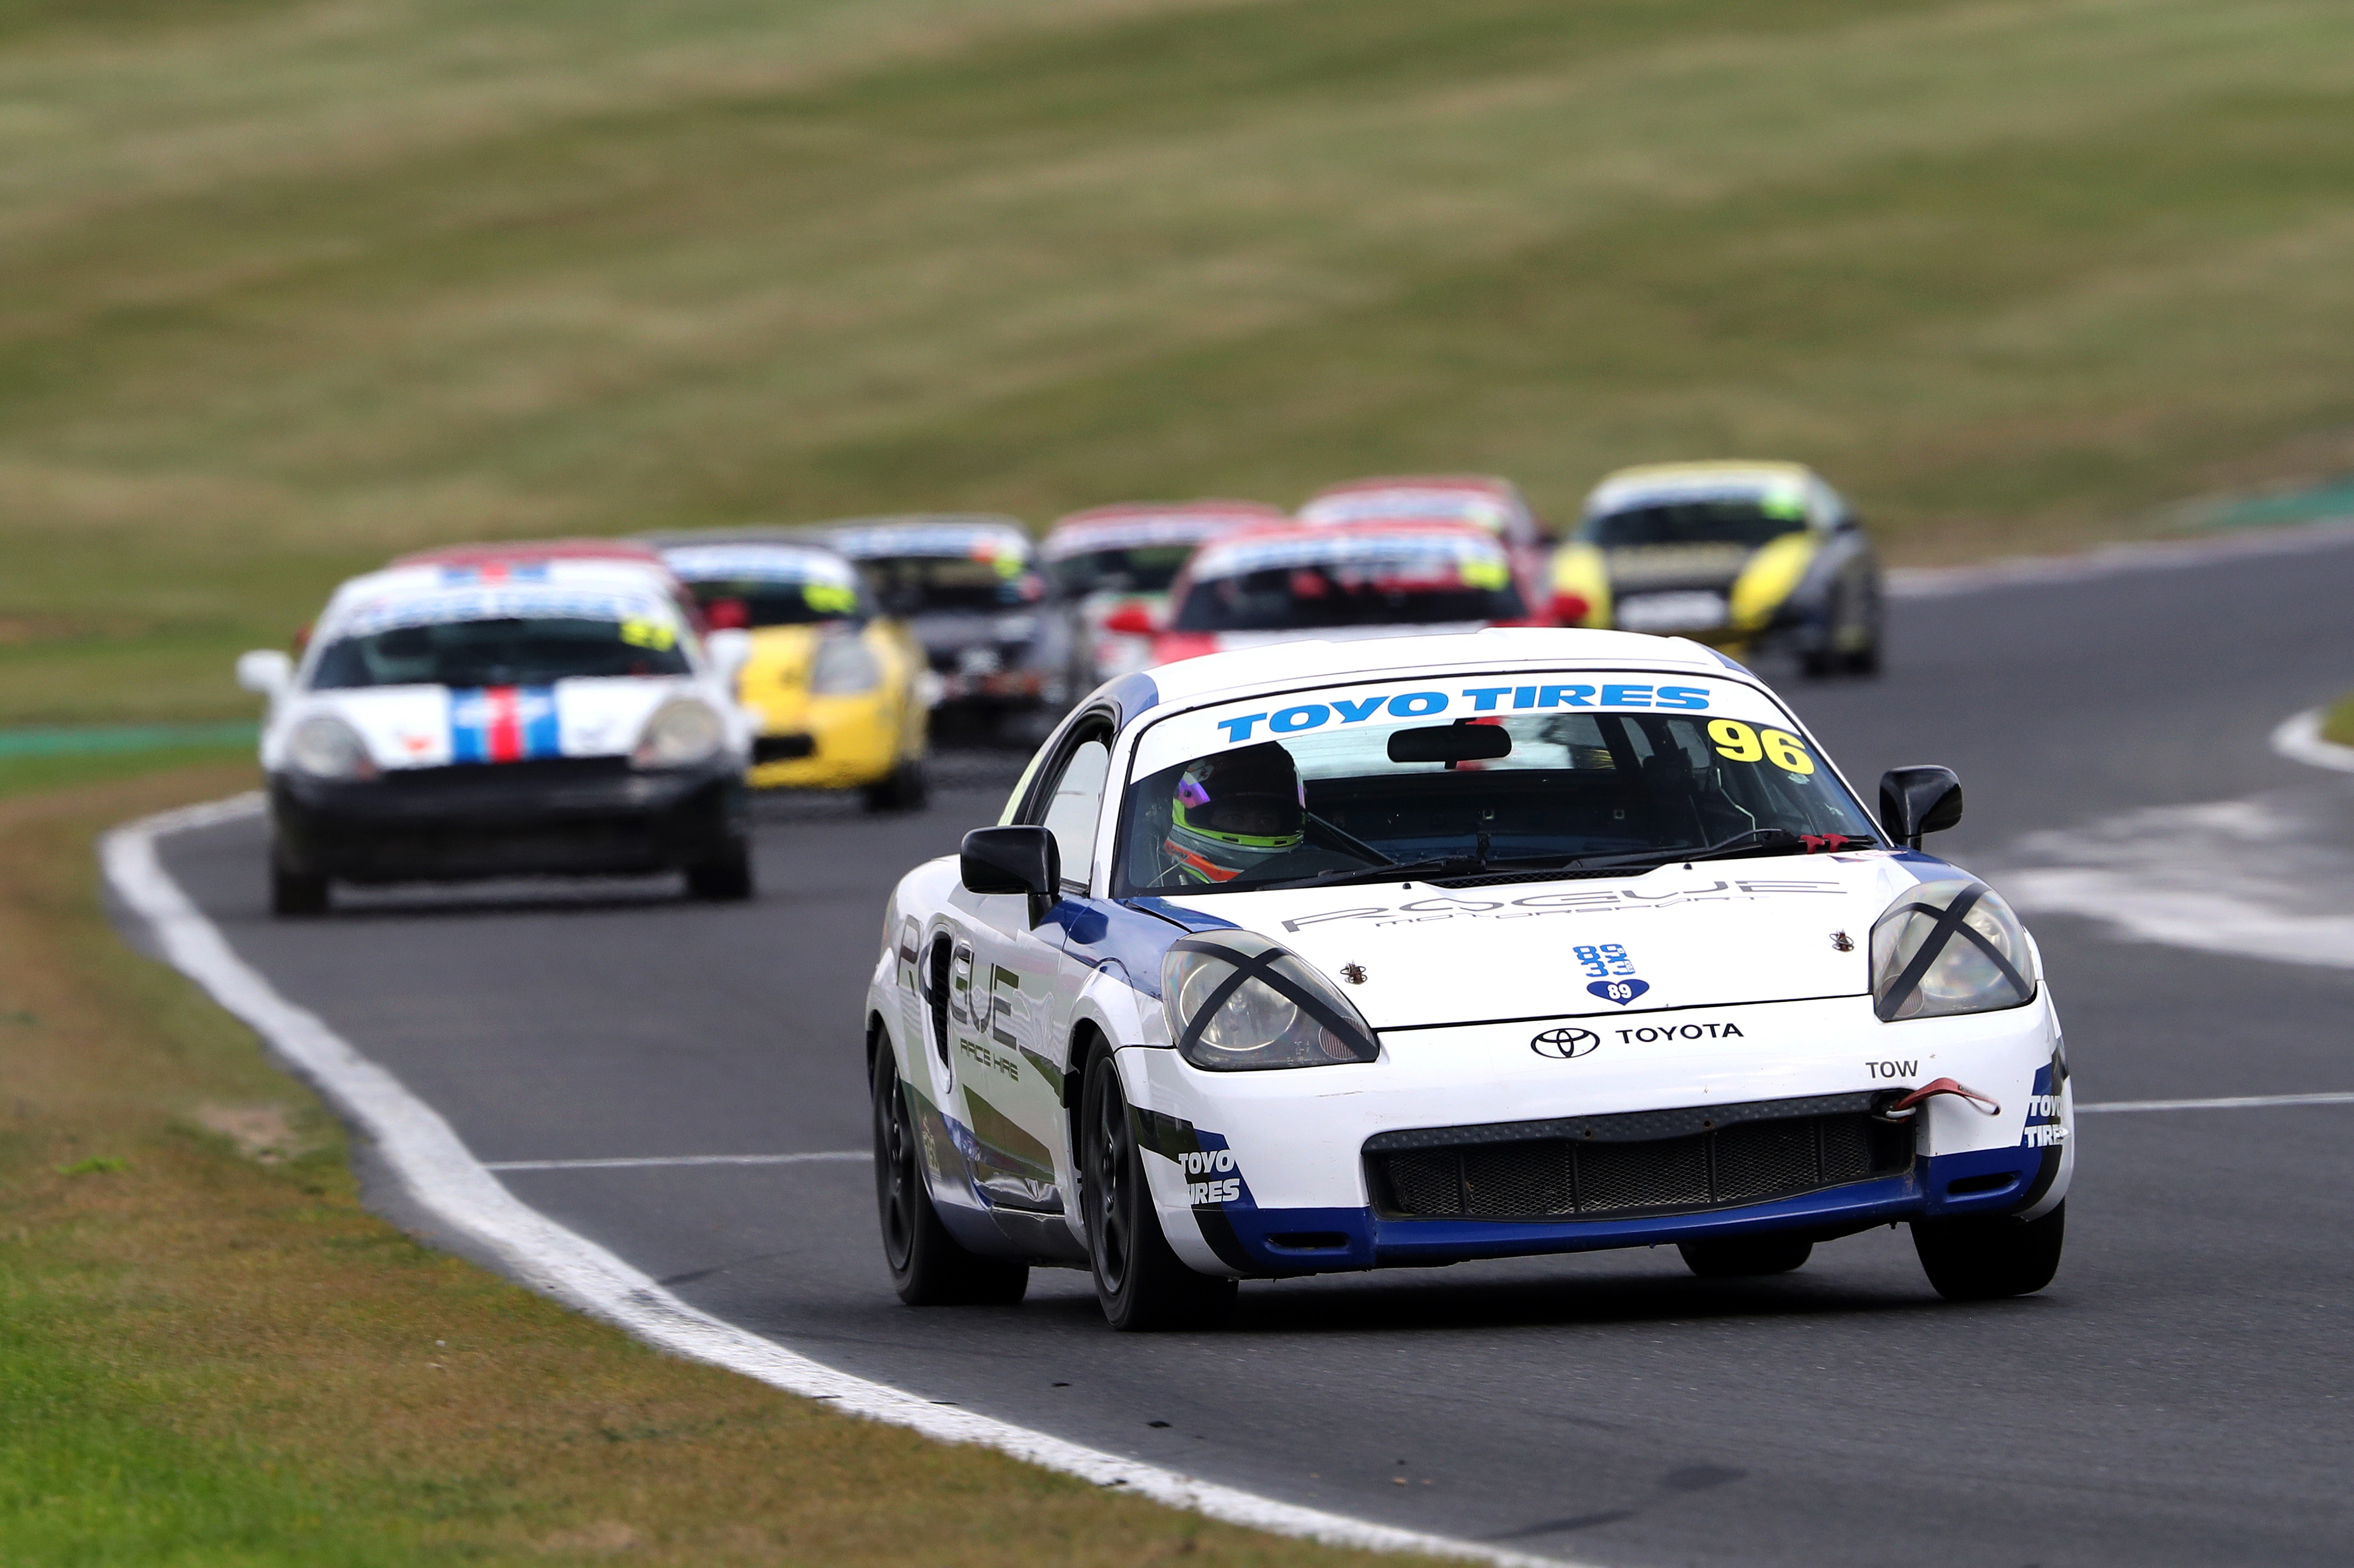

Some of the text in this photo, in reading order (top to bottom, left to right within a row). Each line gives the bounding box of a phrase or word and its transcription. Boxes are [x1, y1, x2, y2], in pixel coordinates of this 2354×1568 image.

[1217, 684, 1710, 743] TOYO TIRES
[1708, 719, 1815, 775] 96
[1281, 880, 1848, 933] ROGUE
[1607, 983, 1633, 1000] 89
[1615, 1023, 1744, 1044] TOYOTA
[960, 1038, 991, 1068] RACE
[1865, 1060, 1919, 1079] TOW
[1178, 1149, 1235, 1174] TOYO
[1187, 1178, 1240, 1205] IRES
